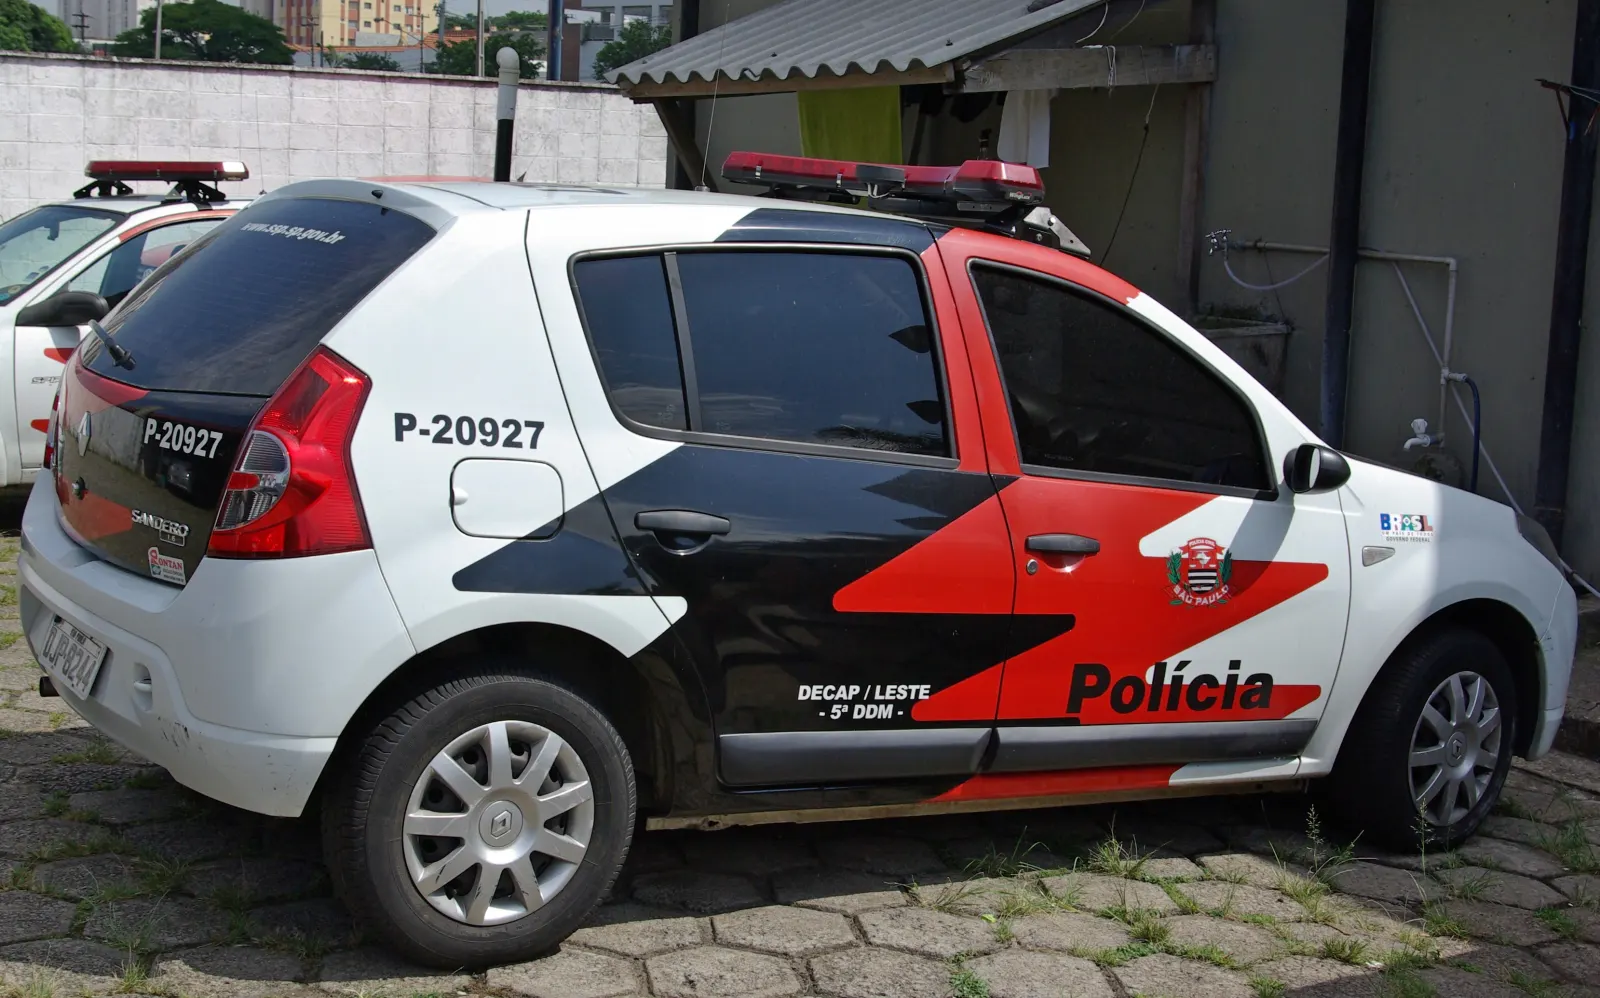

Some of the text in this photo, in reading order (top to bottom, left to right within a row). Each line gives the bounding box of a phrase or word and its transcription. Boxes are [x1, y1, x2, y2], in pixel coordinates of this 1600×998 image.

[240, 222, 346, 244] www.ssp.sp.gov.br
[143, 417, 223, 459] P-20927
[394, 412, 545, 449] P-20927
[131, 509, 189, 537] SANDERO
[1380, 513, 1433, 531] BRASIL
[1195, 584, 1229, 605] PAULO
[798, 685, 931, 700] DECAP / LESTE
[1066, 660, 1274, 714] Polícia
[853, 704, 894, 719] DDM
